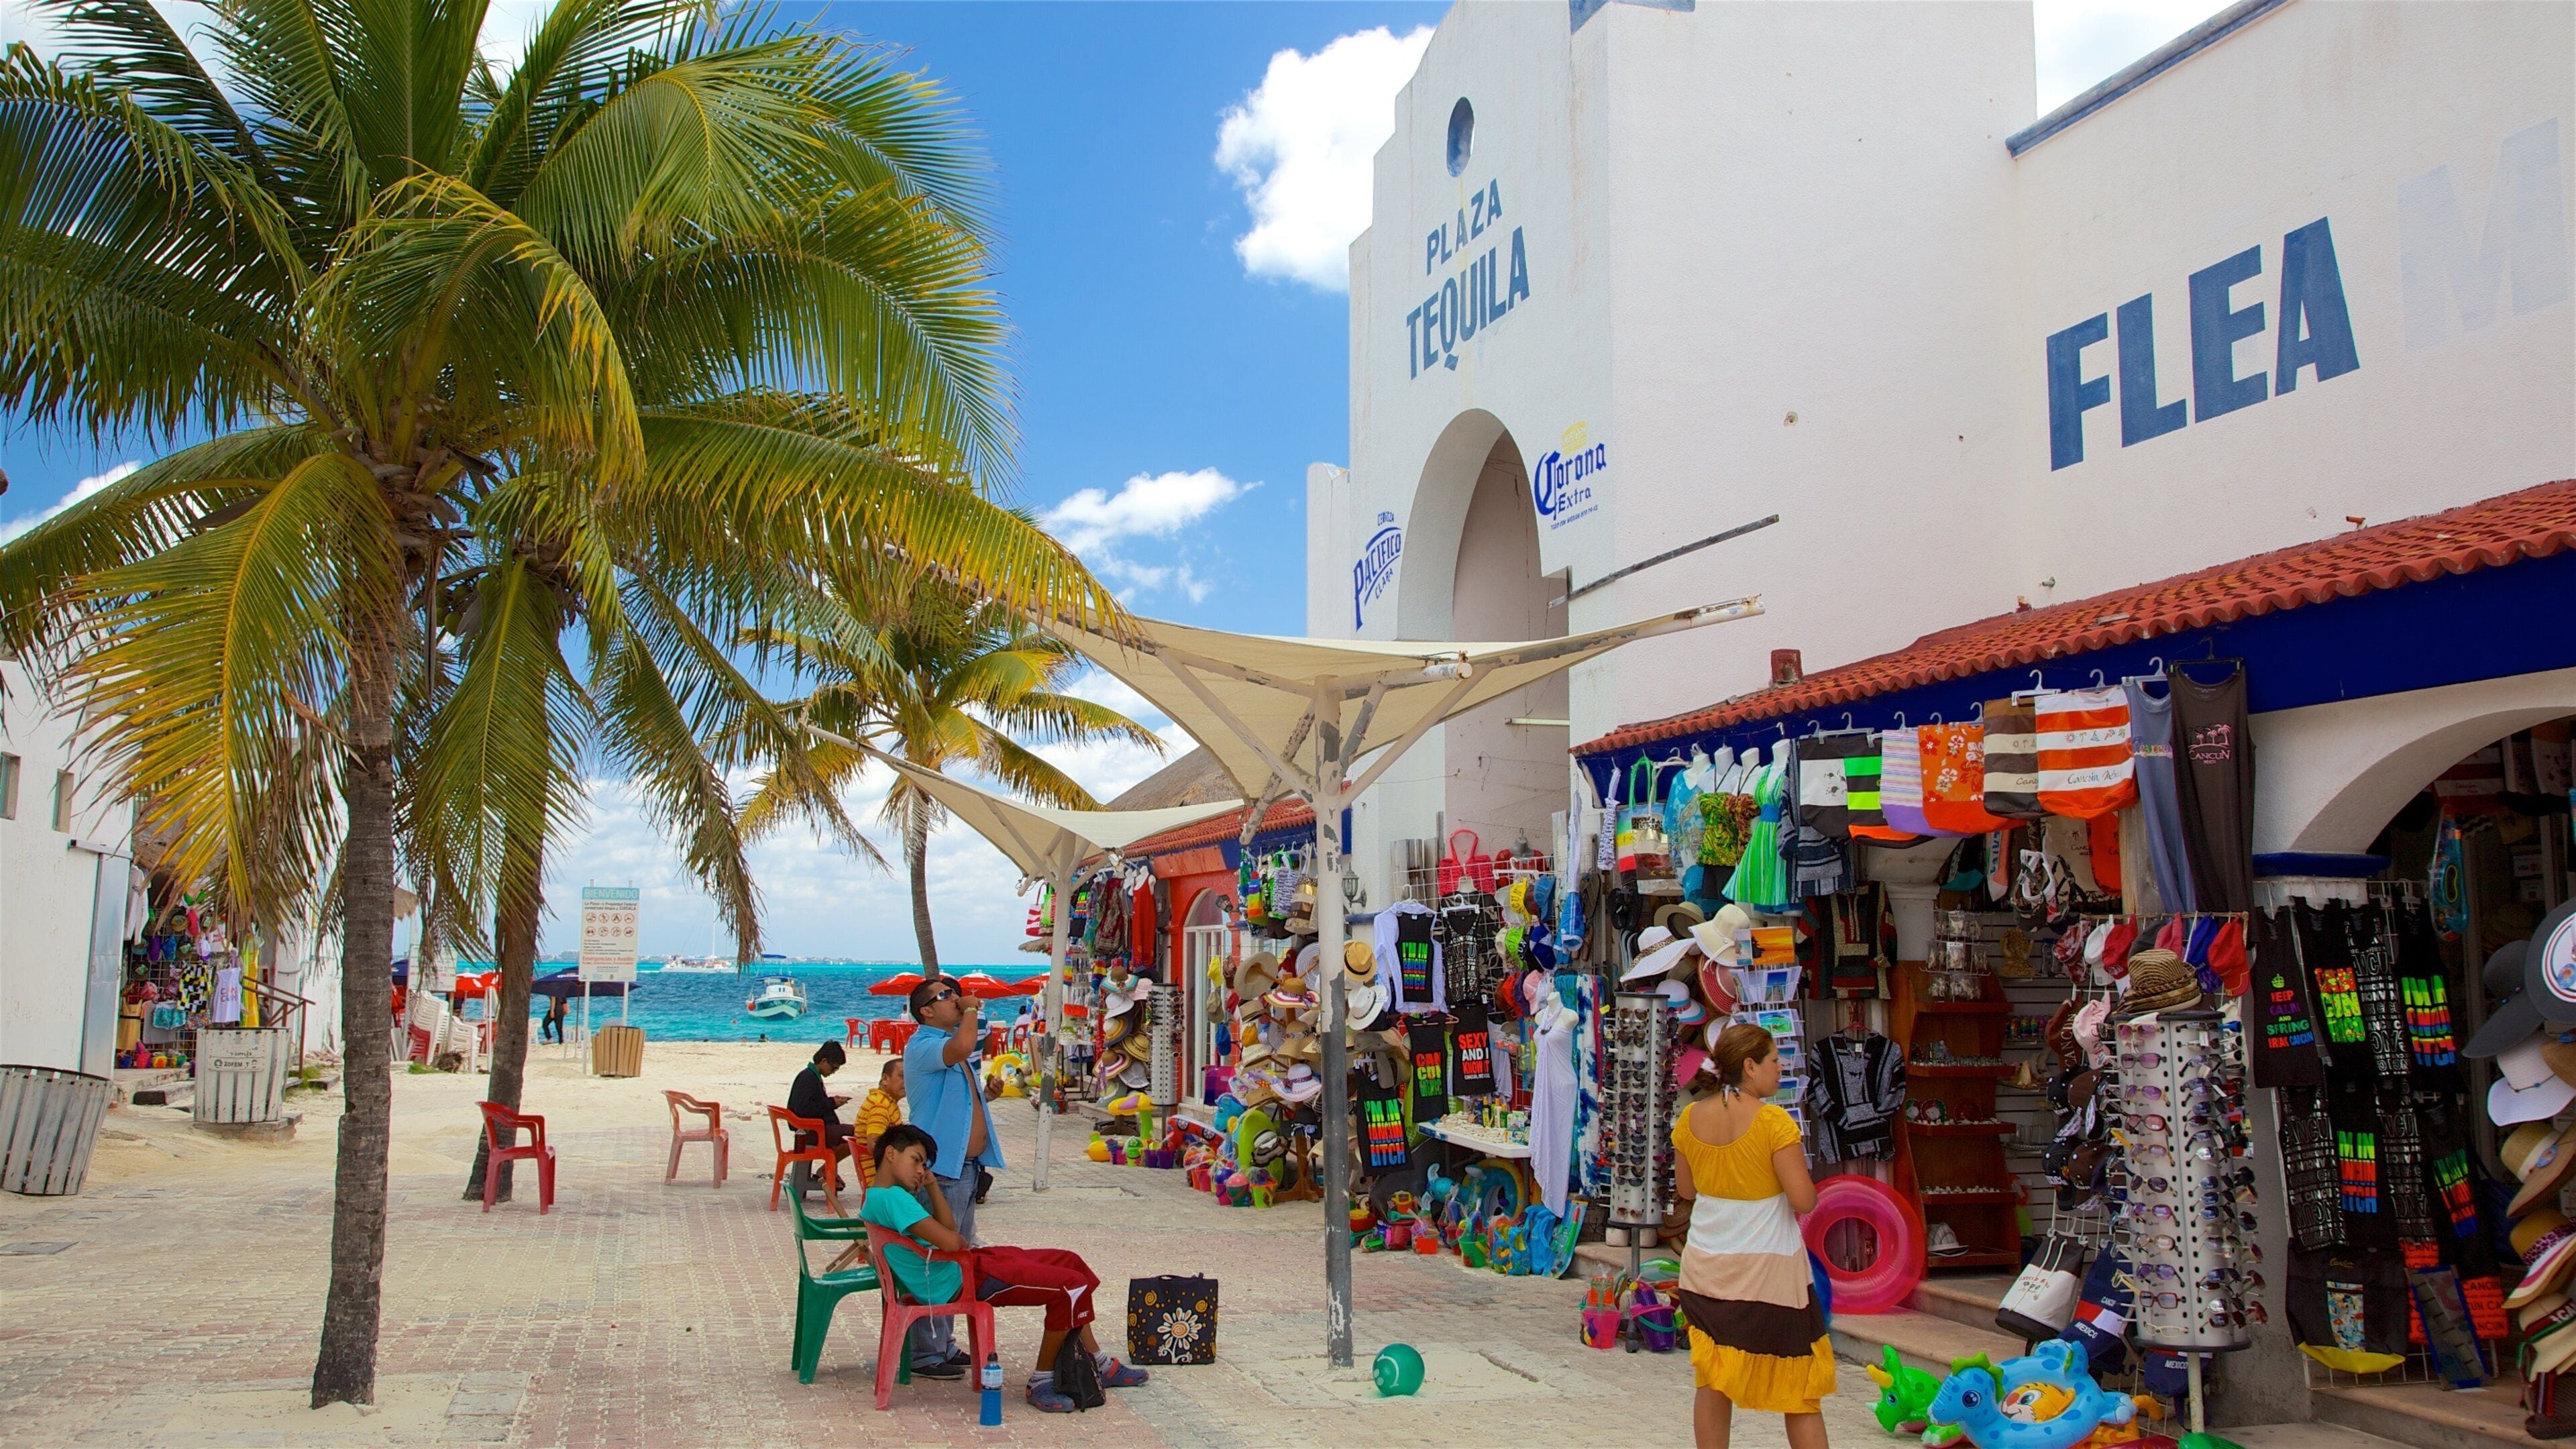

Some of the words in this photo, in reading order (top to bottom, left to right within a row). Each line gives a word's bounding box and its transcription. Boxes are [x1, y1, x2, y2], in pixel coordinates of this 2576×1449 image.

[1426, 178, 1503, 276] PLAZA
[1407, 225, 1529, 381] TEQUILA
[2046, 216, 2360, 472] FLEA
[1534, 443, 1607, 521] Corona
[1558, 487, 1591, 514] Extra
[1377, 511, 1395, 526] CERVEZA
[1353, 533, 1402, 633] PACIFICO
[1375, 568, 1393, 599] CLARA
[2188, 750, 2231, 760] CANCUN
[584, 888, 638, 899] BIENVENIDO
[2270, 989, 2294, 1002] KEEP
[2269, 1002, 2301, 1015] CALM
[2266, 1019, 2310, 1036] SPRING
[1458, 1032, 1488, 1049] SEXY
[2289, 1031, 2314, 1046] CANCUN
[1462, 1048, 1483, 1061] AND
[1485, 1047, 1489, 1059] I
[1462, 1061, 1483, 1075] KNOW
[1483, 1060, 1489, 1074] IT
[2074, 1322, 2098, 1339] MEXICO
[2164, 1359, 2188, 1370] MEXICO
